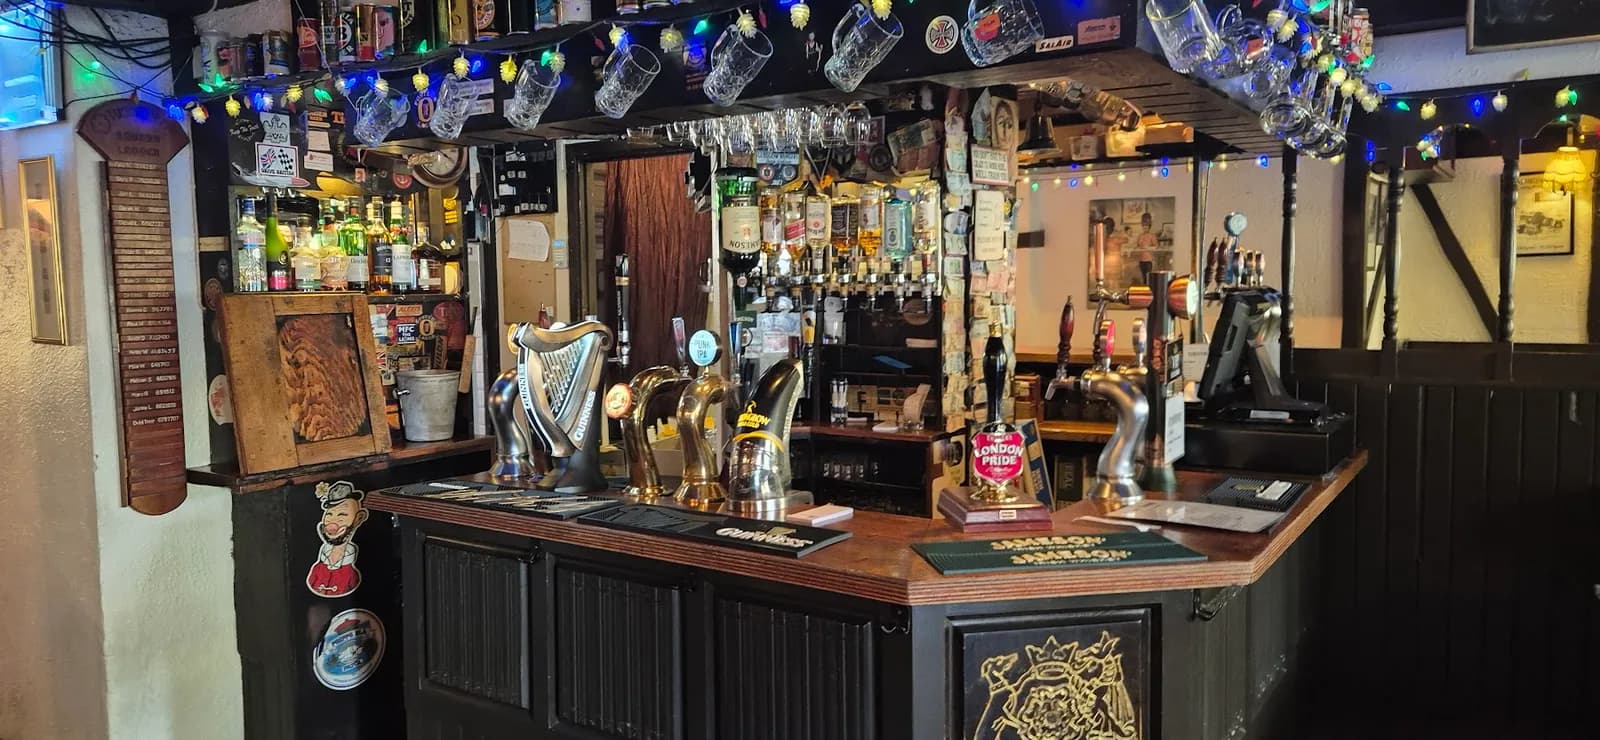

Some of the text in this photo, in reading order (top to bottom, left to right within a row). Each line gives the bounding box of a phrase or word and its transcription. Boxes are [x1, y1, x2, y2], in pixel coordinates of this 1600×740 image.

[575, 390, 597, 440] GUINNESS
[974, 443, 1024, 458] LONDON
[981, 454, 1017, 466] PRIDE
[715, 527, 814, 548] GUINNESS
